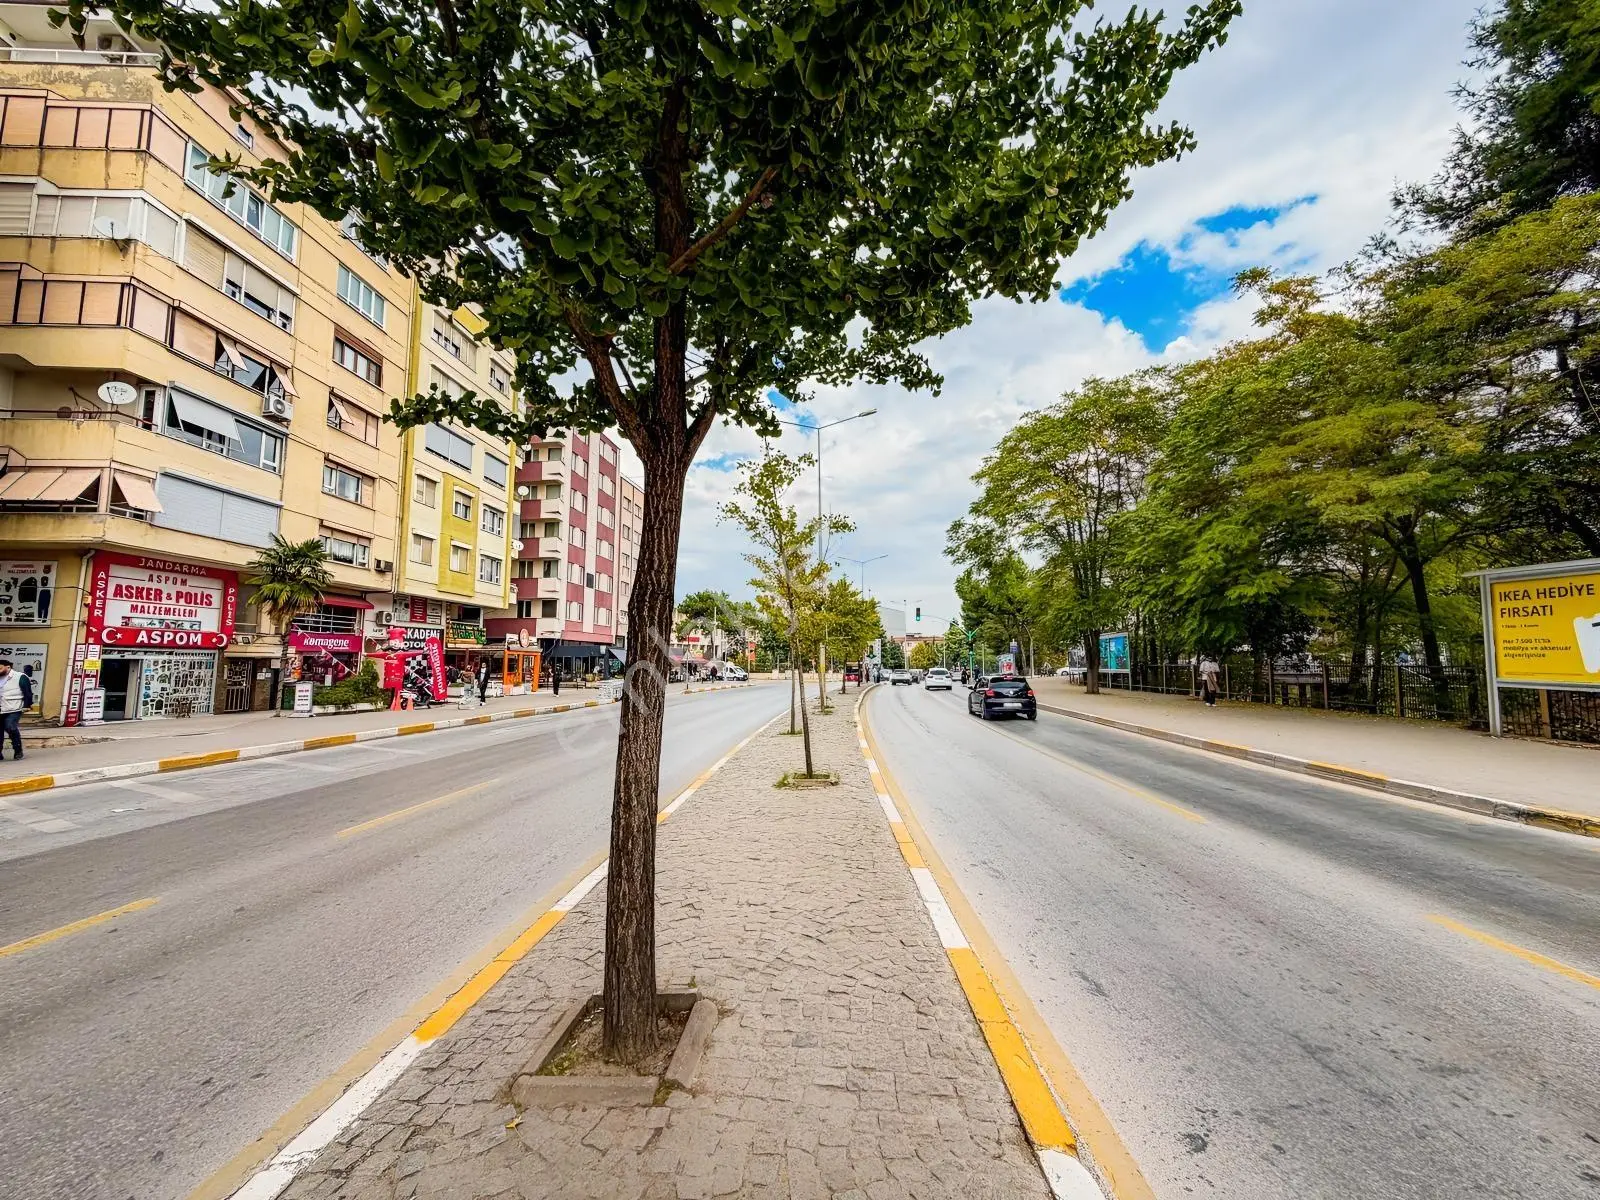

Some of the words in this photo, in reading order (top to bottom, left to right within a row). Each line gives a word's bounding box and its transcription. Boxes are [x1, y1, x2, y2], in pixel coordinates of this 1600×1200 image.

[139, 559, 207, 576] JANDARMA
[148, 574, 188, 586] ASPOM
[94, 571, 106, 617] ASKER
[112, 584, 163, 603] ASKER
[165, 592, 173, 601] &
[175, 591, 213, 607] POLİS
[1499, 589, 1532, 602] IKEA
[1536, 582, 1595, 600] HEDİYE
[1500, 604, 1553, 618] FIRSATI
[135, 630, 202, 645] ASPOM
